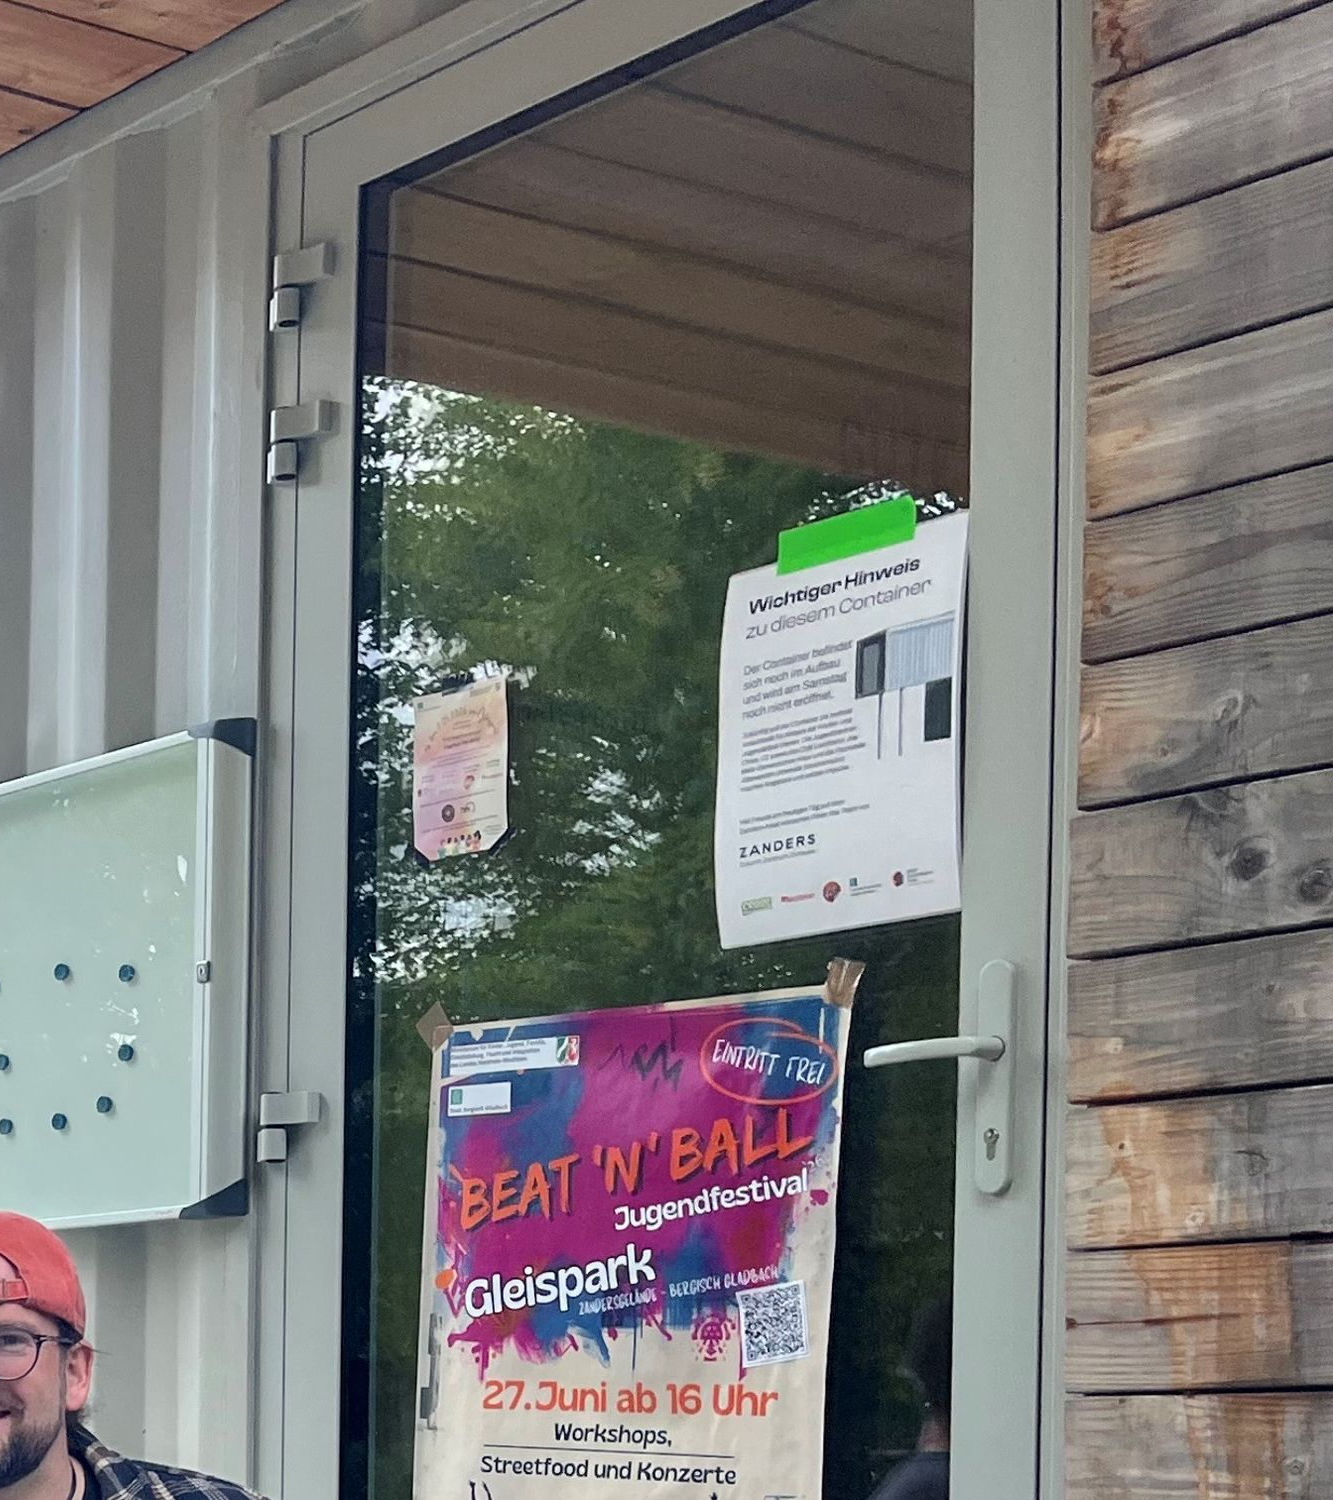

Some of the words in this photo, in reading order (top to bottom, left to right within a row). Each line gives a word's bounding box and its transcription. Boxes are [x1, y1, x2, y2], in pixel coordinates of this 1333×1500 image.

[746, 624, 769, 640] zu
[770, 605, 836, 633] diesem
[839, 578, 933, 614] Container
[748, 580, 843, 615] Wichtiger
[844, 558, 921, 590] Hinweis
[739, 833, 816, 859] ZANDERS
[711, 1038, 778, 1076] EINTRITT
[785, 1057, 827, 1086] FREI
[460, 1153, 579, 1231] BEAT
[669, 1108, 814, 1182] BALL
[614, 1166, 808, 1232] Jugendfestival
[464, 1242, 656, 1318] Gleispark
[669, 1275, 721, 1298] BERGISCH
[617, 1384, 657, 1415] ab
[666, 1384, 702, 1415] 16
[713, 1384, 779, 1417] Uhr
[554, 1423, 673, 1448] Workshops,
[480, 1456, 588, 1480] Streetfood
[593, 1461, 632, 1480] und
[637, 1461, 737, 1485] Konzerte
